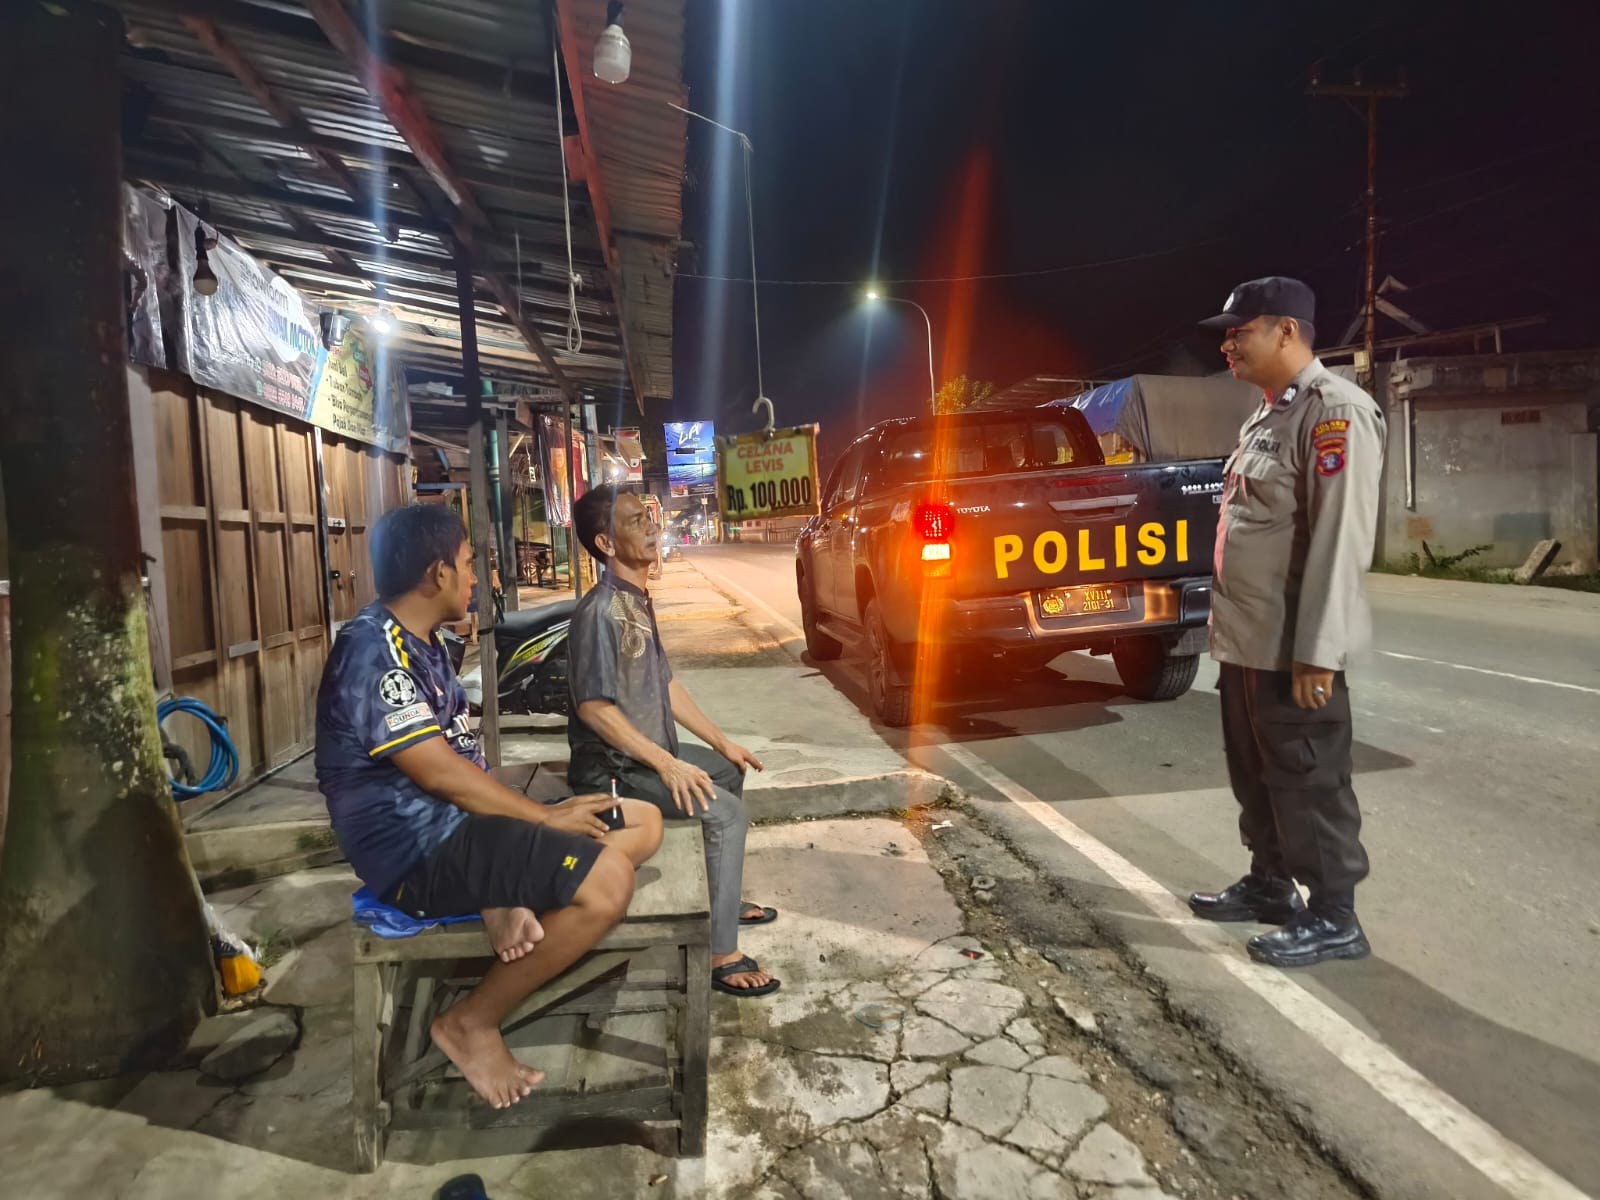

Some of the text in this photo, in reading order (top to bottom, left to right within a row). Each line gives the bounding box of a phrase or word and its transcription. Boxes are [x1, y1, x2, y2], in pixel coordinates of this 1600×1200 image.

[737, 441, 793, 459] CELANA
[745, 458, 785, 475] LEVIS
[956, 505, 991, 514] TOYOTA
[994, 520, 1188, 579] POLISI
